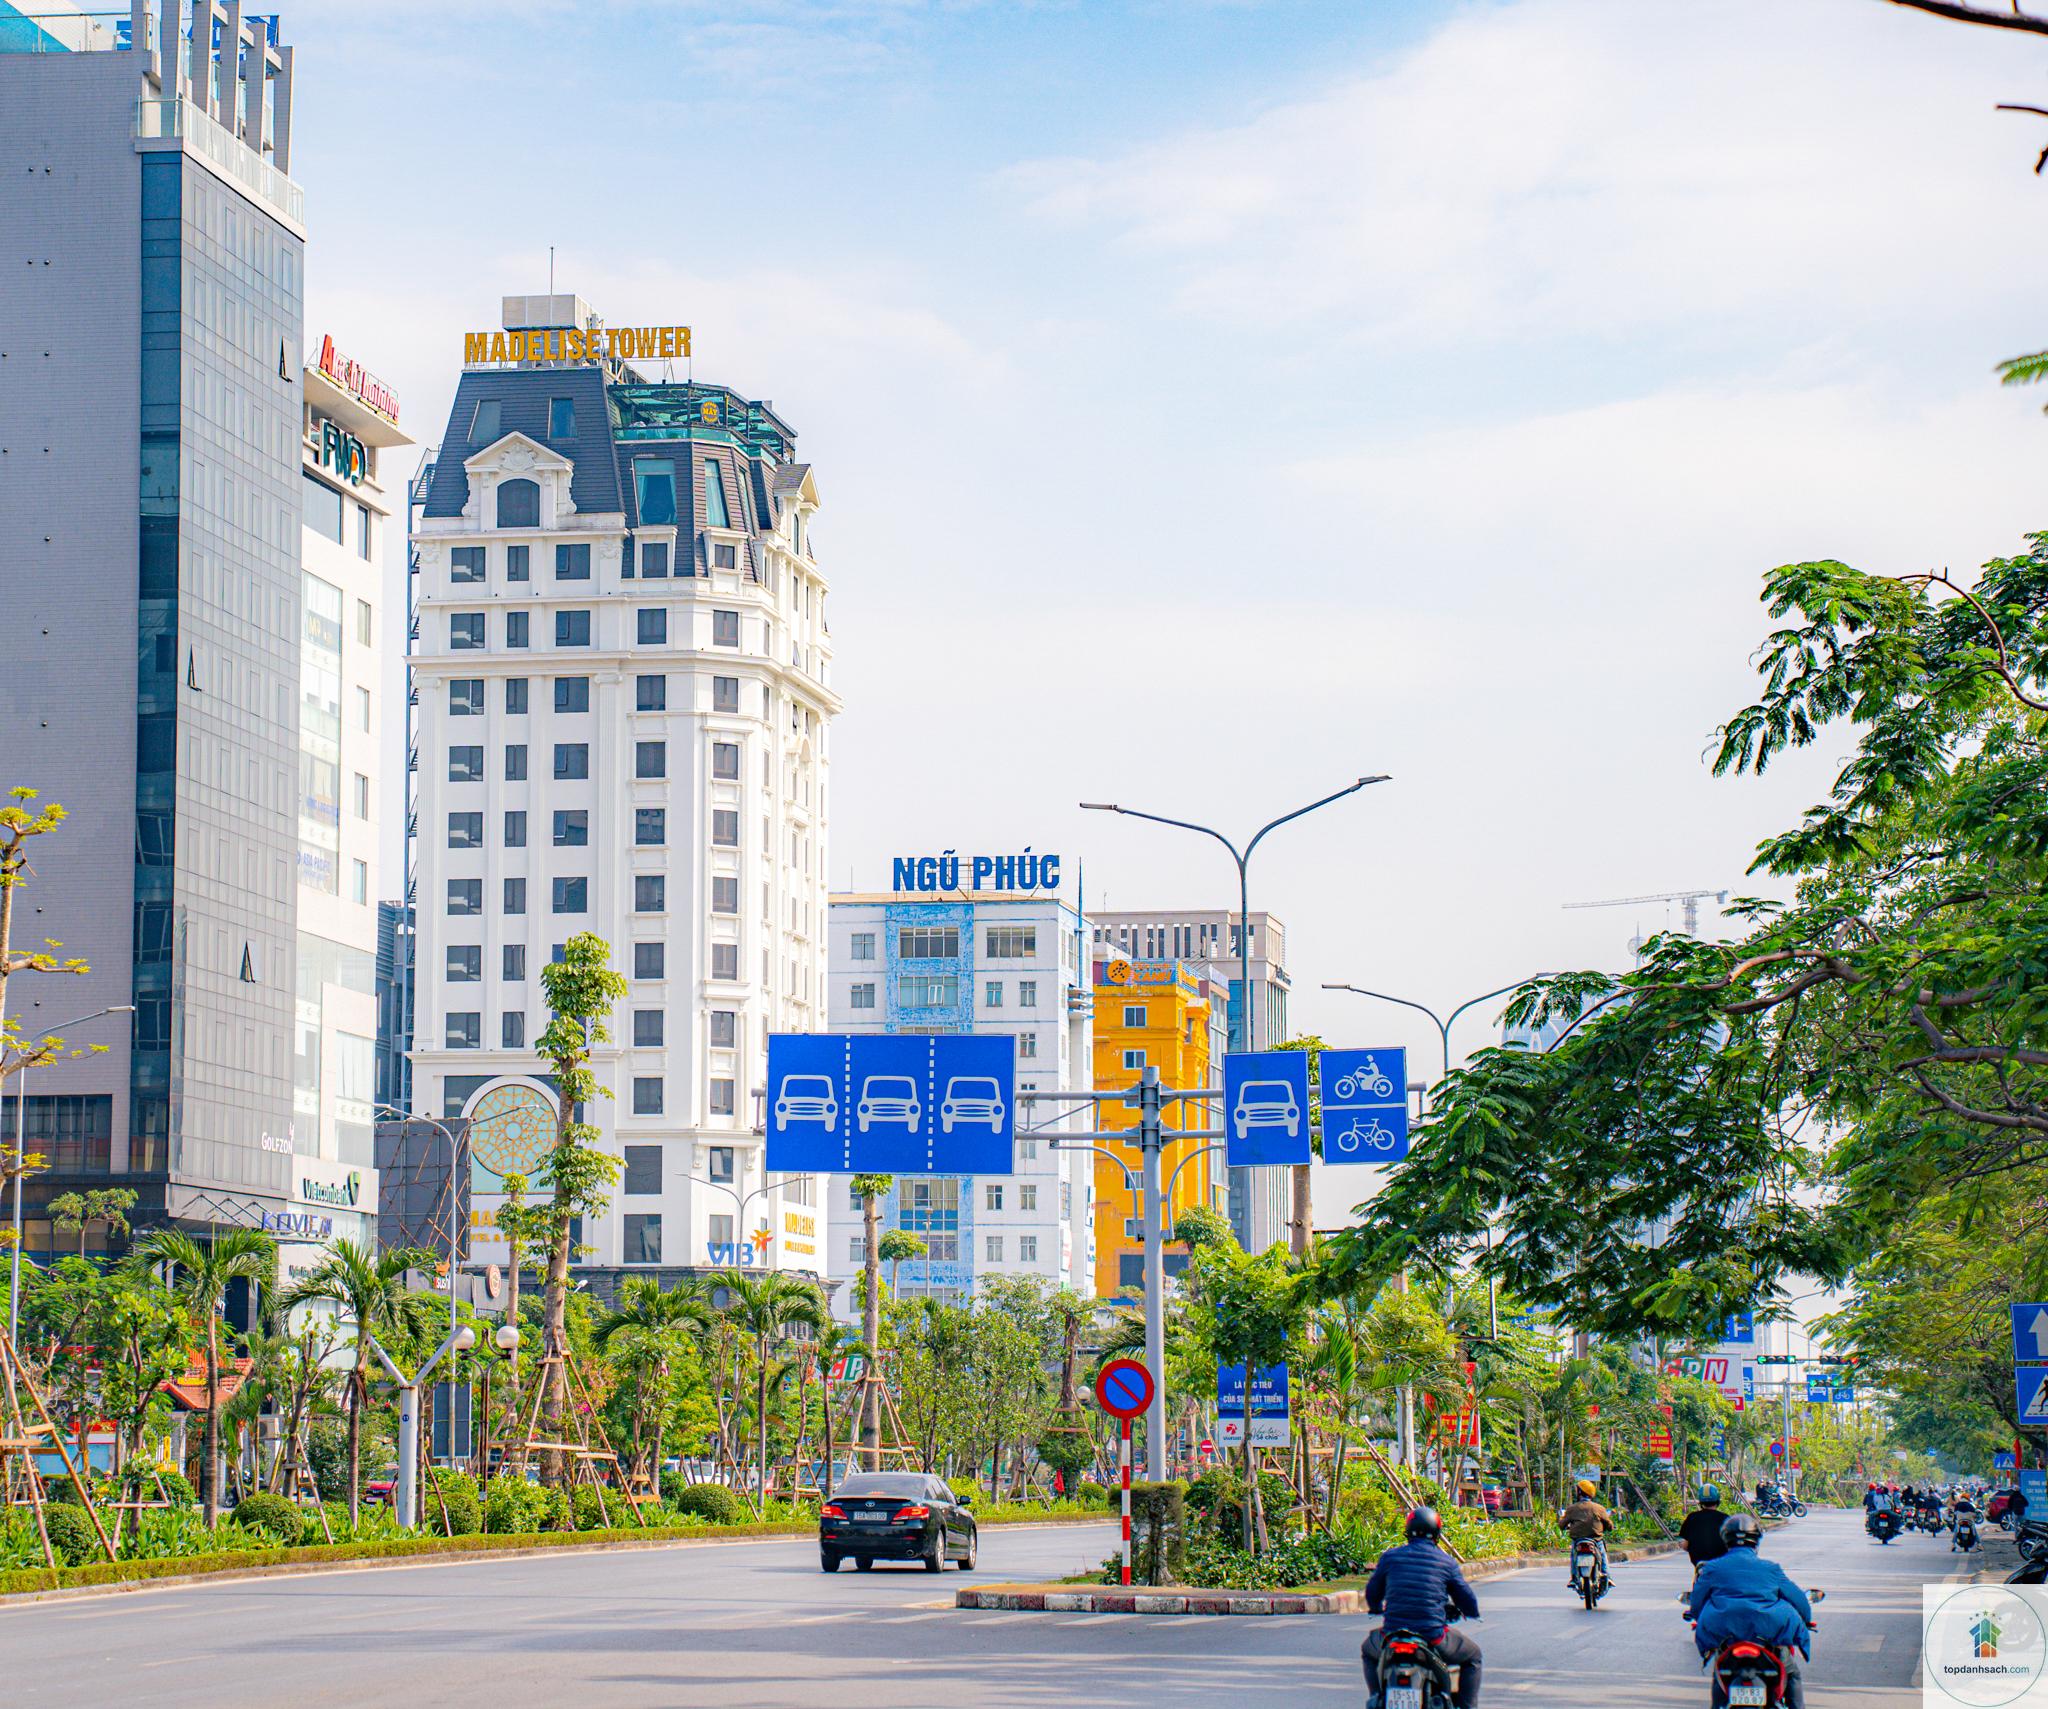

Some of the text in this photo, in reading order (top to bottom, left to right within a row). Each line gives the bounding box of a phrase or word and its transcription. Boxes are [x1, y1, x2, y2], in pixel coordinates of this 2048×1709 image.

[465, 326, 691, 363] MADELISE TOWER
[893, 846, 1060, 891] NGŨ PHÚC
[707, 1242, 754, 1266] VIB
